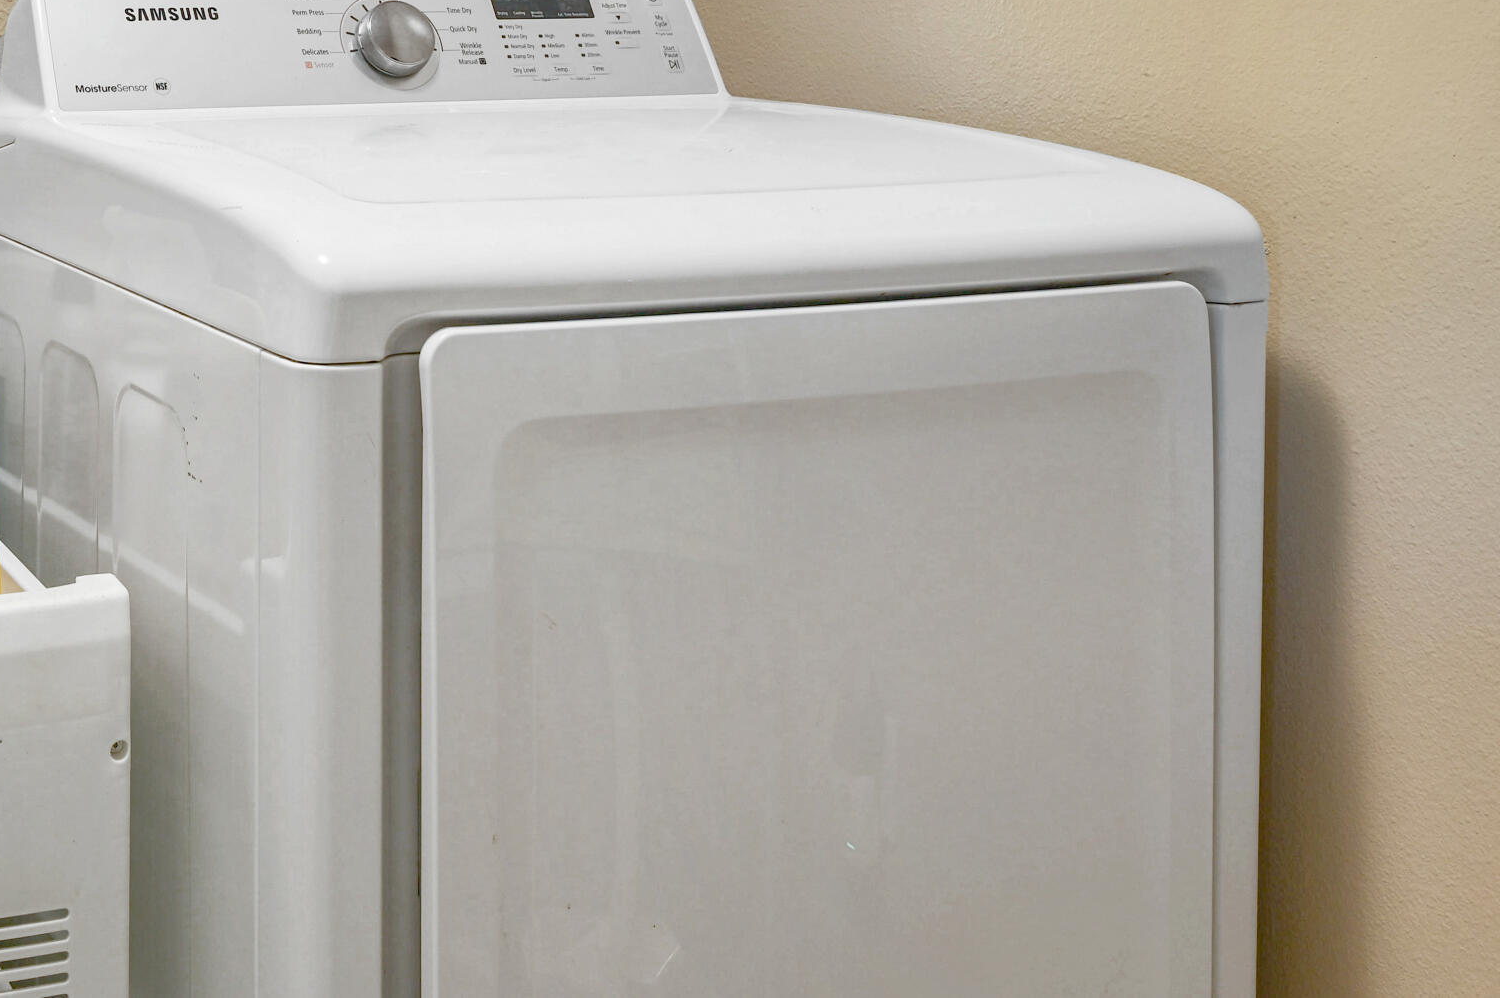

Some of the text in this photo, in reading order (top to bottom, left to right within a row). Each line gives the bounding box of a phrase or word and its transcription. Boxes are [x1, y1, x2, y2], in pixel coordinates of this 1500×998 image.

[124, 7, 219, 22] SAMSUNG
[292, 9, 325, 17] Perm Press
[461, 7, 472, 15] Dry
[296, 28, 322, 36] Bedding
[449, 25, 477, 33] Quick Dry
[301, 48, 329, 56] Delicates
[513, 67, 523, 75] Dry
[75, 84, 148, 93] MoistureSensor
[155, 82, 168, 91] NSF
